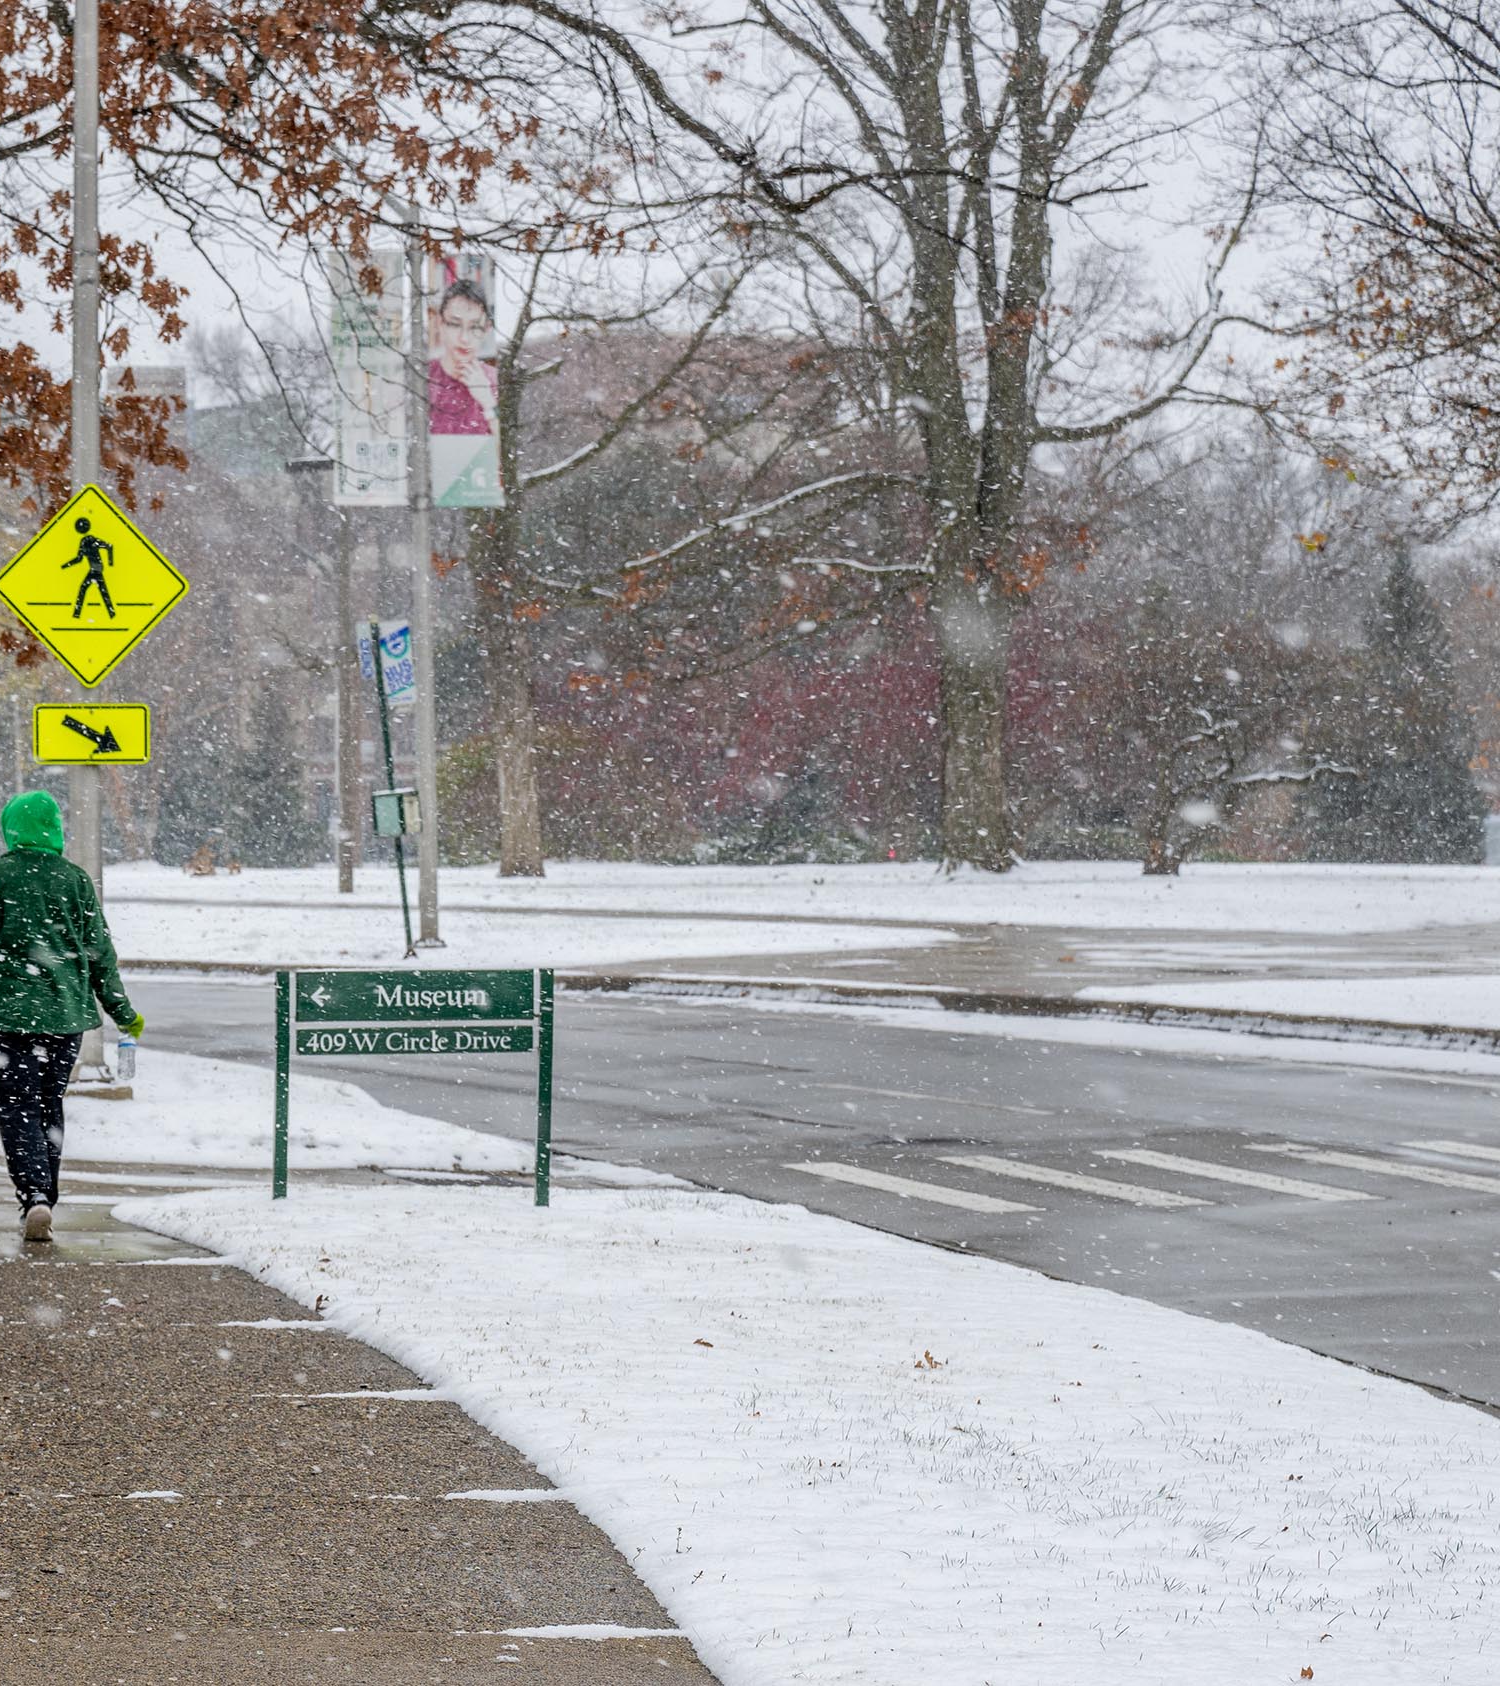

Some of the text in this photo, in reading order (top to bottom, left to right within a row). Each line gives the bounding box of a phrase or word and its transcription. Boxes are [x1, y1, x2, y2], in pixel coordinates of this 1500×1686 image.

[376, 985, 488, 1008] Museum
[306, 1031, 512, 1052] 409 W Circle Drive
